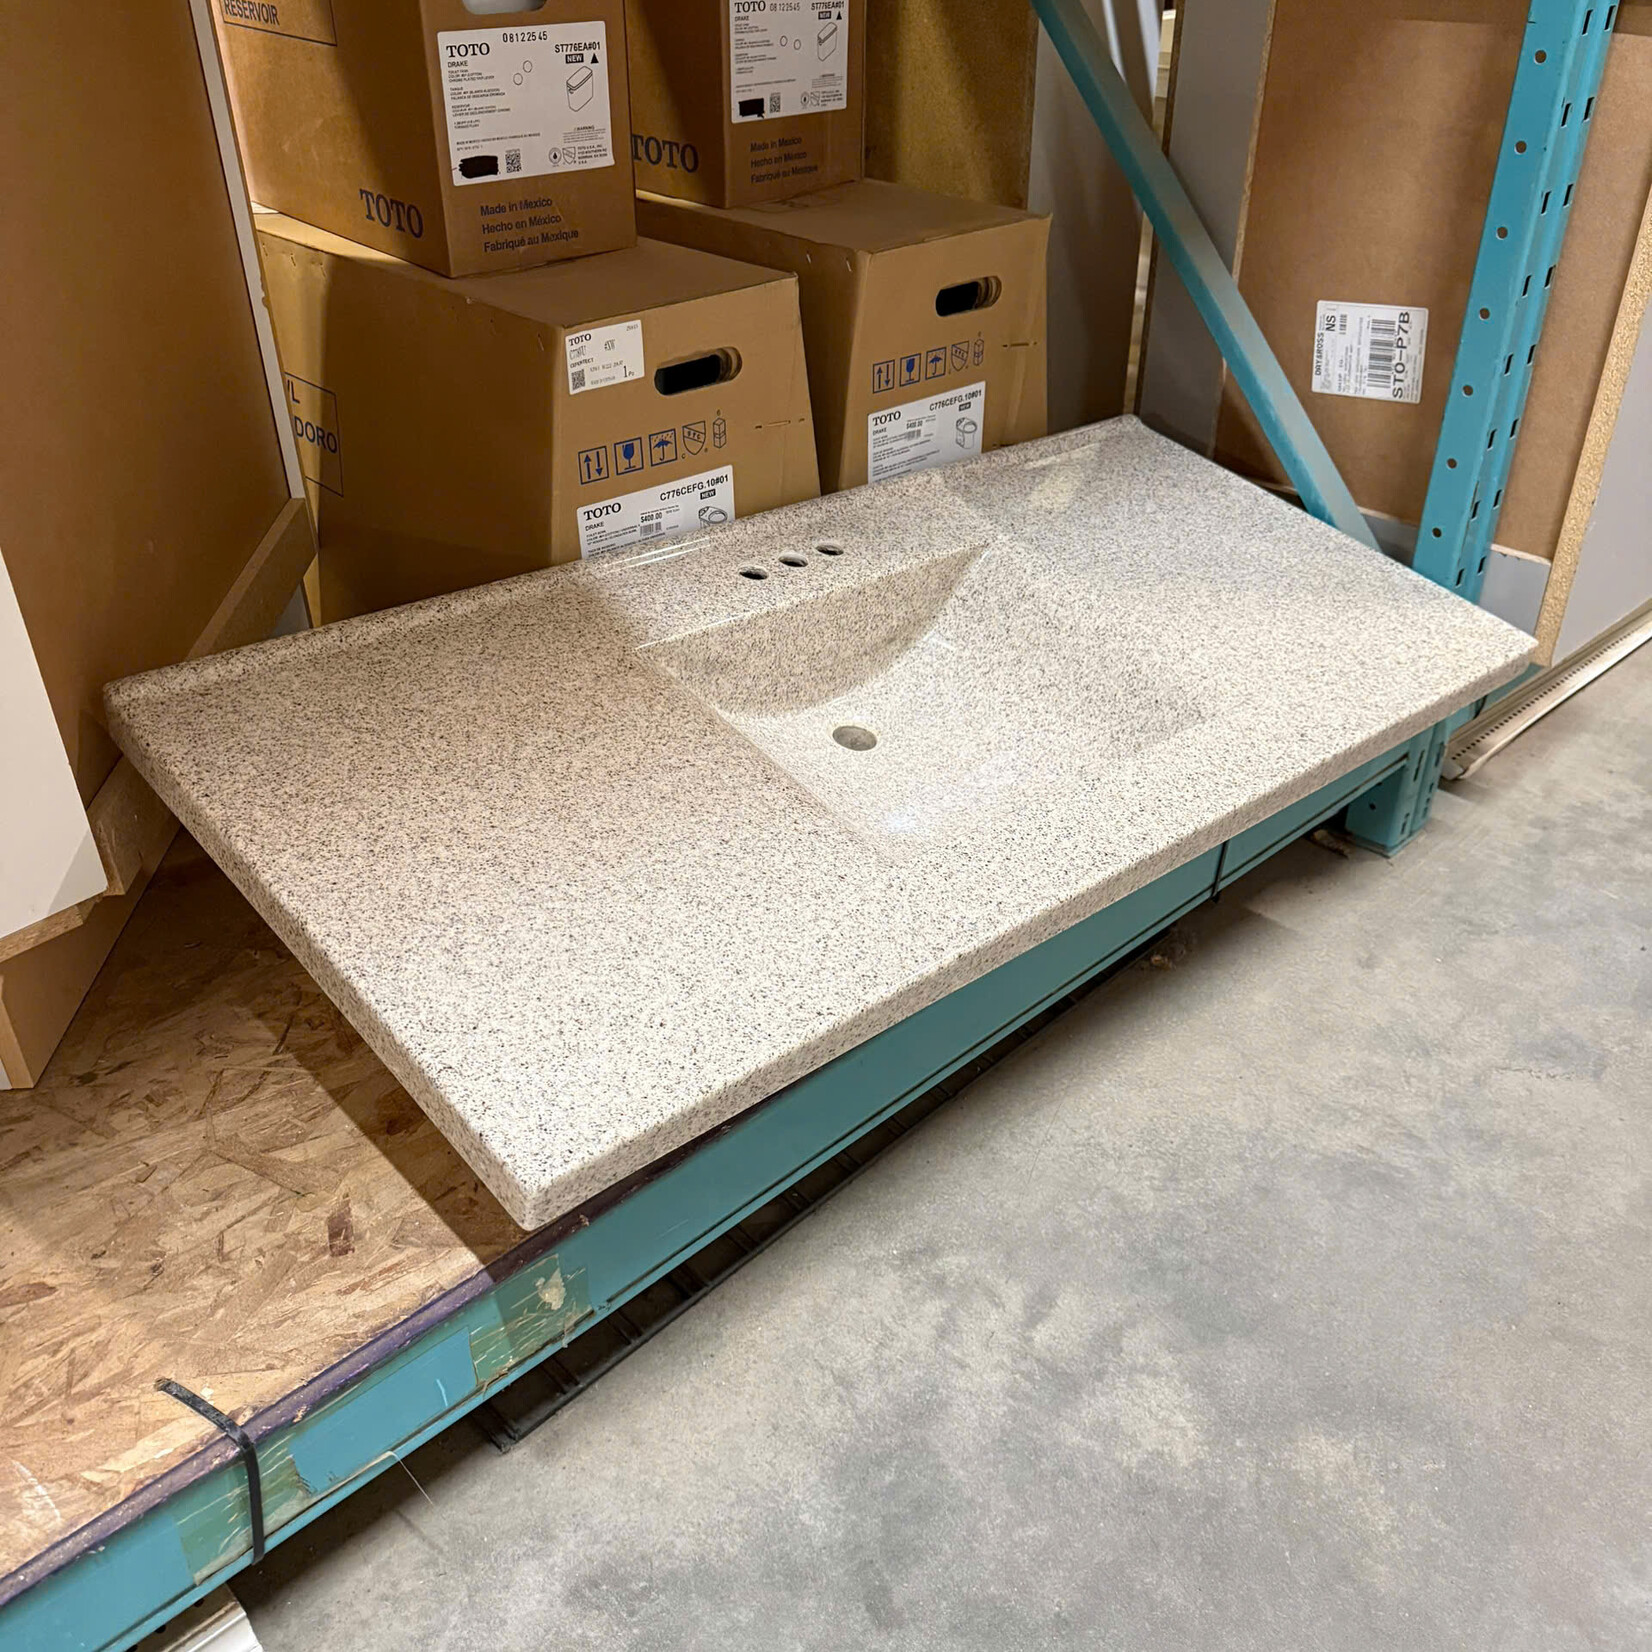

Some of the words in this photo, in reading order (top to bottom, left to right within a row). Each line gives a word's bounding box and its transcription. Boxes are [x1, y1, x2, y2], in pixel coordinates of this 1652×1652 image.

[224, 0, 280, 25] RESERVOIR
[734, 1, 766, 13] TOTO
[446, 42, 490, 58] TOTO
[554, 41, 601, 53] ST776EA#01
[447, 60, 468, 68] DRAKE
[566, 53, 583, 63] NEW
[631, 134, 699, 173] TOTO
[750, 142, 769, 152] Made
[770, 140, 777, 148] in
[751, 157, 773, 168] Hecho
[359, 189, 424, 239] TOTO
[480, 204, 506, 216] Made
[508, 202, 518, 212] in
[520, 197, 553, 210] Mexico
[482, 221, 513, 235] Hecho
[515, 220, 527, 229] en
[527, 236, 539, 246] au
[541, 230, 579, 245] Mexique
[1325, 315, 1337, 332] NS
[569, 333, 592, 346] TOTO
[1315, 332, 1325, 376] DAY&ROSS
[1392, 311, 1410, 399] STO-P7B
[872, 410, 901, 426] TOTO
[873, 427, 887, 436] DRAKE
[660, 474, 729, 501] C776CEFG.10#01
[701, 490, 715, 499] NEW
[583, 502, 622, 521] TOTO
[640, 512, 663, 523] $400.00
[585, 522, 604, 531] DRAKE
